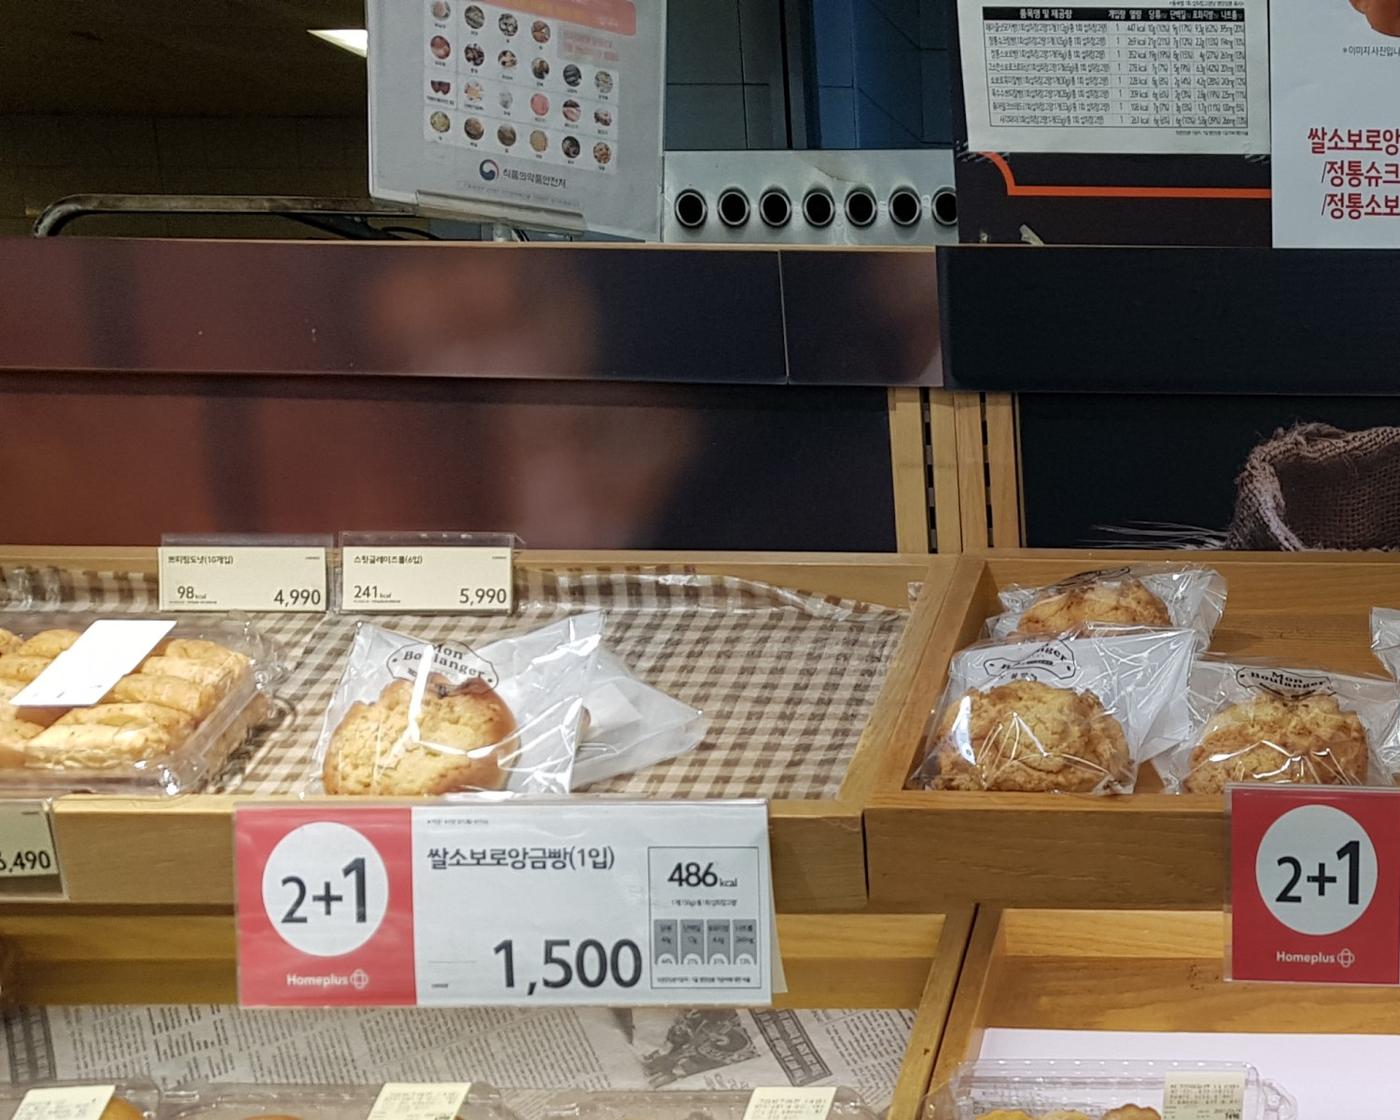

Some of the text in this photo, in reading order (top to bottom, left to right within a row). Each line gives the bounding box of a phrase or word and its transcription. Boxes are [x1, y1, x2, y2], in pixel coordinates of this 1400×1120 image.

[177, 585, 195, 599] 98
[274, 589, 321, 607] 4,990
[354, 585, 378, 598] 241
[459, 588, 507, 606] 5,990
[403, 650, 485, 678] Bolanger
[427, 846, 615, 872] 쌀소보로앙금빵(1입)
[667, 862, 738, 888] 486 kcal
[1275, 840, 1361, 905] 2+1
[280, 857, 368, 924] 2+1
[493, 938, 643, 996] 1,500
[1276, 950, 1336, 966] Homeplus
[287, 971, 349, 987] Homeplus
